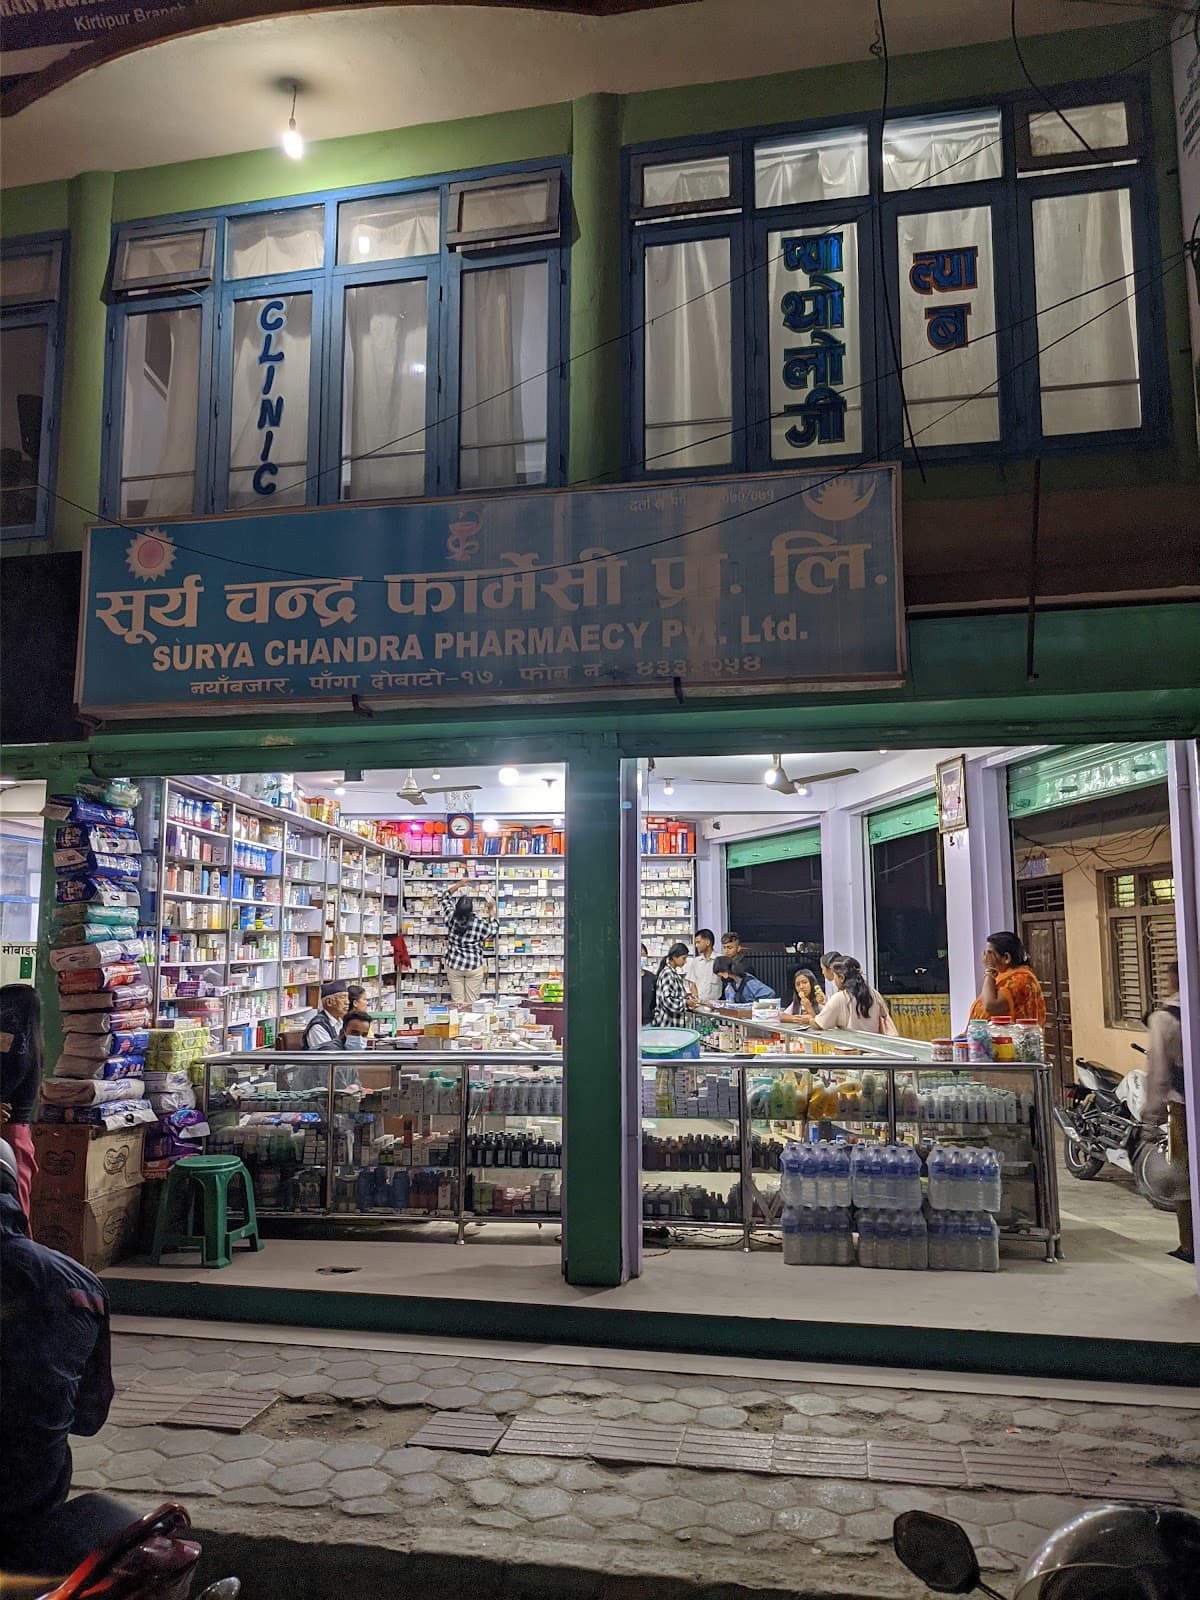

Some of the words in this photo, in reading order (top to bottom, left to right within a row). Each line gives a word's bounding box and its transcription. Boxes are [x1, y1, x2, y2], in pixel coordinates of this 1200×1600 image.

[74, 13, 131, 31] Kirtipur
[253, 300, 284, 495] CLINIC
[95, 574, 205, 645] सूर्य
[223, 576, 364, 627] चन्द्र
[383, 546, 628, 616] फार्मेसी
[770, 530, 888, 595] लि.
[152, 640, 255, 672] SURYA
[264, 633, 424, 666] CHANDRA
[434, 621, 649, 660] PHARMAECY
[741, 612, 808, 645] Ltd.
